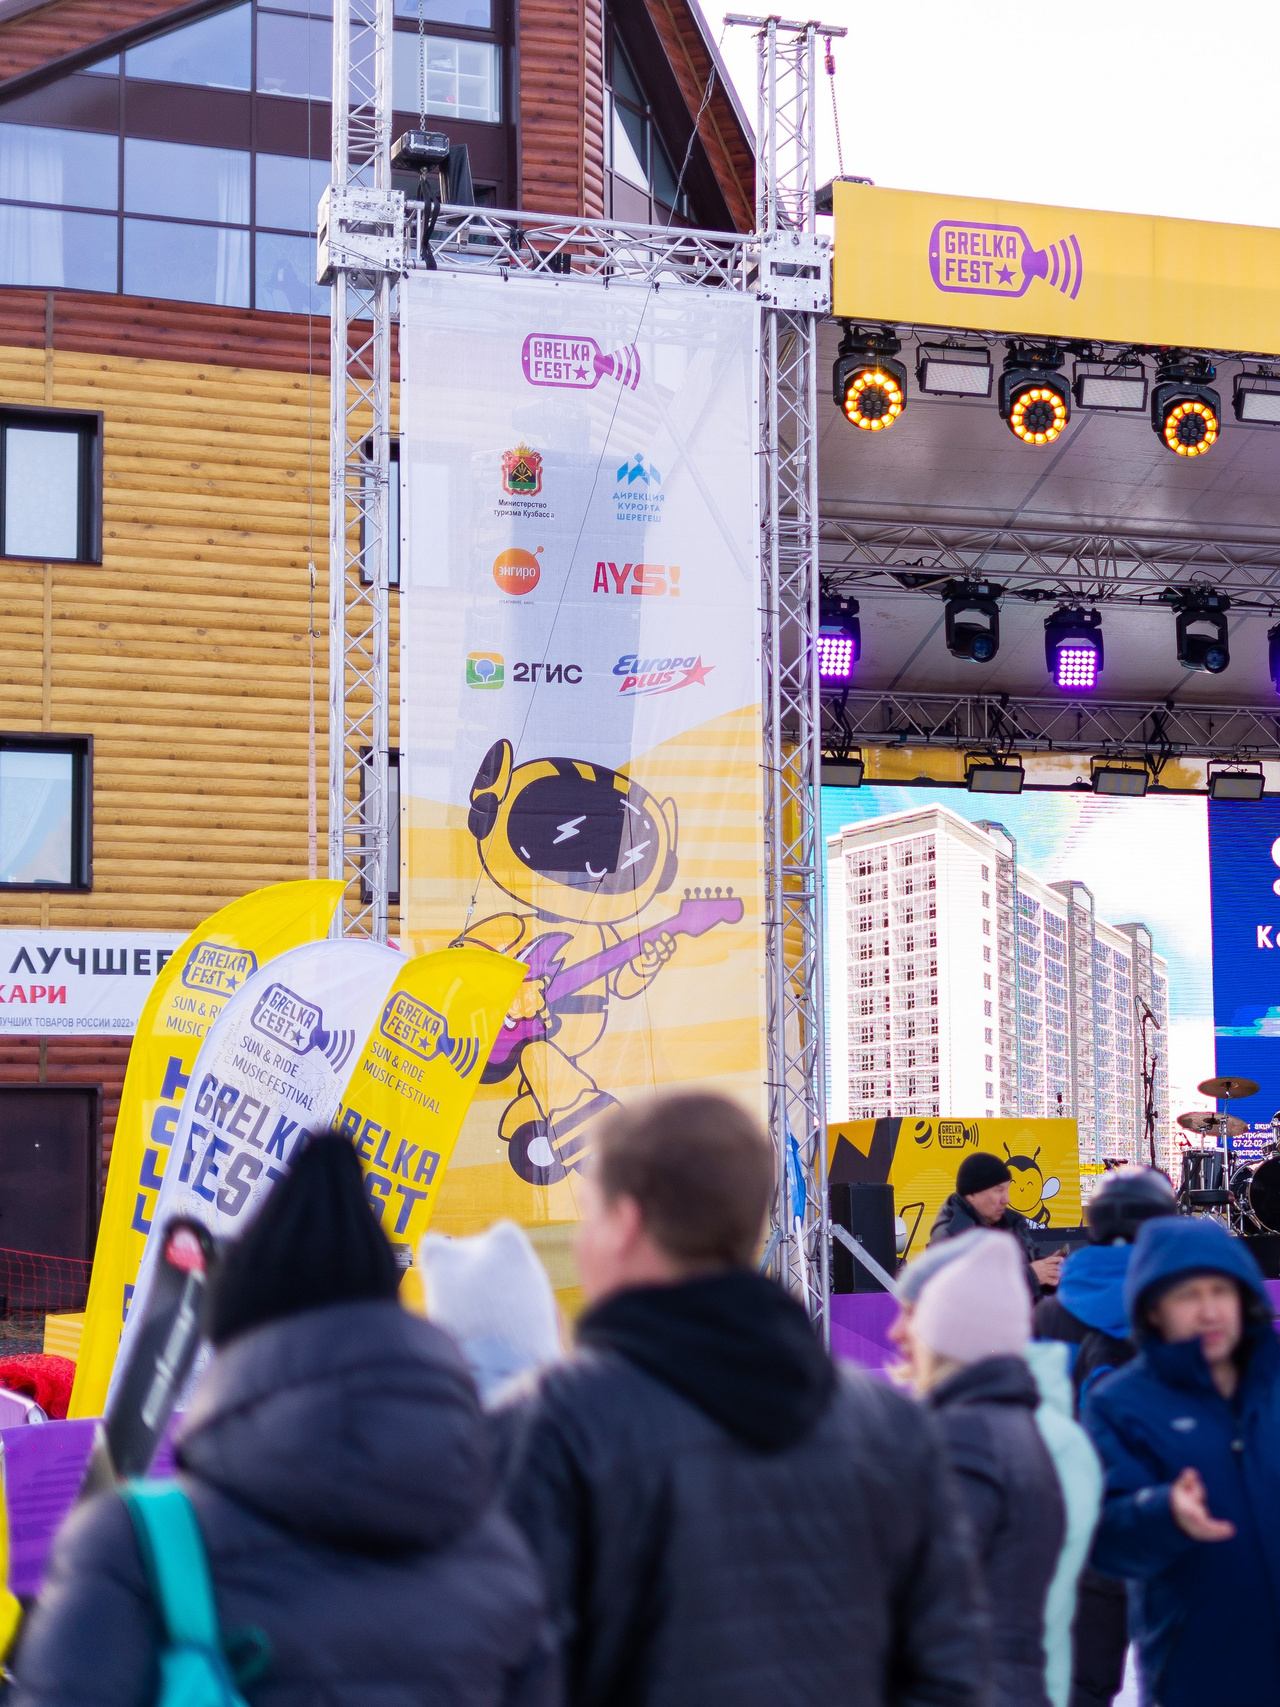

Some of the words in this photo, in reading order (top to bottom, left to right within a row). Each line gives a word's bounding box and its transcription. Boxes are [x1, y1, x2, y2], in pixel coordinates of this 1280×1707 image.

[944, 230, 1017, 259] GRELKA
[945, 258, 994, 284] FEST
[533, 340, 590, 363] GRELKA
[534, 361, 571, 380] FEST
[498, 499, 547, 508] Министерство
[612, 492, 665, 502] ДИРЕКЦИЯ
[617, 502, 661, 512] КУРОРТА
[493, 509, 521, 517] туризма
[523, 509, 555, 519] Кузбасса
[616, 513, 662, 523] ШЕРЕГЕШ
[498, 566, 536, 580] энгиро
[592, 561, 681, 598] AYS!
[513, 662, 583, 684] 2ГИС
[198, 949, 248, 973] GRELKA
[190, 967, 226, 987] FEST
[171, 995, 197, 1013] SUN
[197, 1002, 206, 1016] &
[269, 991, 316, 1029] GRELKA
[35, 1017, 74, 1028] ТОВАРОВ
[77, 1018, 110, 1028] РОССИИ
[112, 1018, 135, 1028] 2022»
[166, 1015, 204, 1038] MUSIC
[258, 1008, 295, 1039] FEST
[396, 999, 441, 1036] GRELKA
[387, 1015, 420, 1045] FEST
[240, 1035, 264, 1057] SUN
[262, 1049, 271, 1064] &
[273, 1054, 300, 1078] RIDE
[370, 1041, 394, 1063] SUN
[391, 1054, 399, 1069] &
[400, 1059, 426, 1083] RIDE
[232, 1054, 268, 1084] MUSIC
[266, 1074, 314, 1112] FESTIVAL
[362, 1059, 396, 1088] MUSIC
[395, 1079, 440, 1115] FESTIVAL
[941, 1125, 962, 1135] GRELKA
[942, 1135, 956, 1145] FEST
